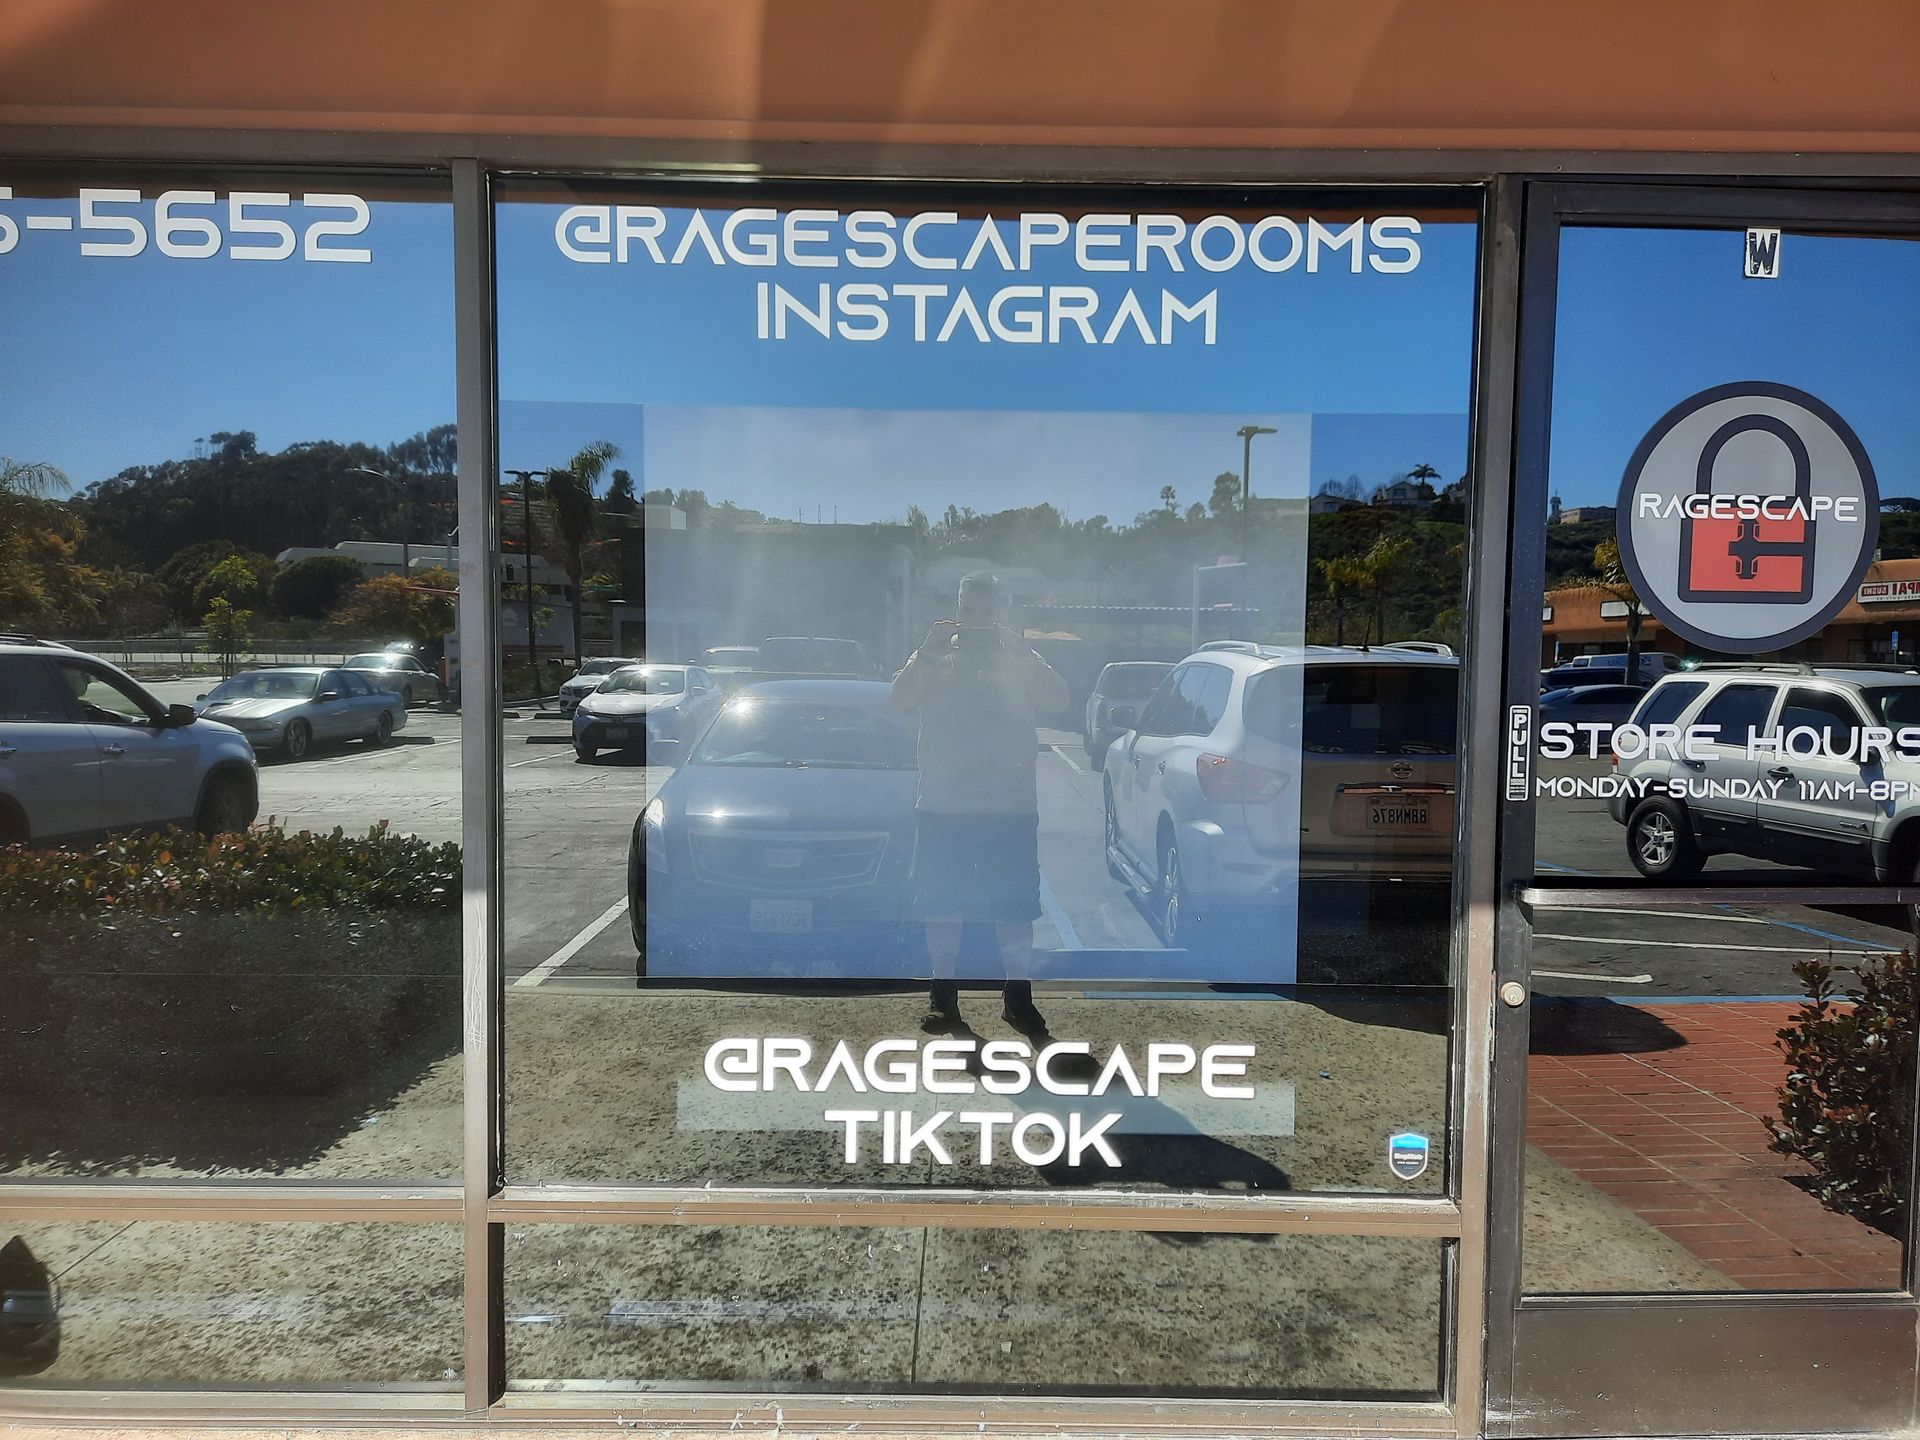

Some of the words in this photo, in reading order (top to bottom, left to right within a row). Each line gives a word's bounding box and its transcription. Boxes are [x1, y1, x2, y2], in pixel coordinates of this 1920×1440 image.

[555, 205, 1422, 274] @RAGESCAPEROOMS
[1749, 232, 1778, 275] W
[758, 282, 1217, 345] INSTAGRAM
[1639, 493, 1859, 521] RAGESCAPE
[1512, 713, 1527, 778] PULL
[1540, 722, 1721, 761] STORE
[1746, 724, 1920, 763] HOURS
[1535, 776, 1783, 799] MONDAY-SUNDAY
[704, 1038, 1256, 1099] @RAGESCAPE
[823, 1110, 1124, 1168] TIKTOK
